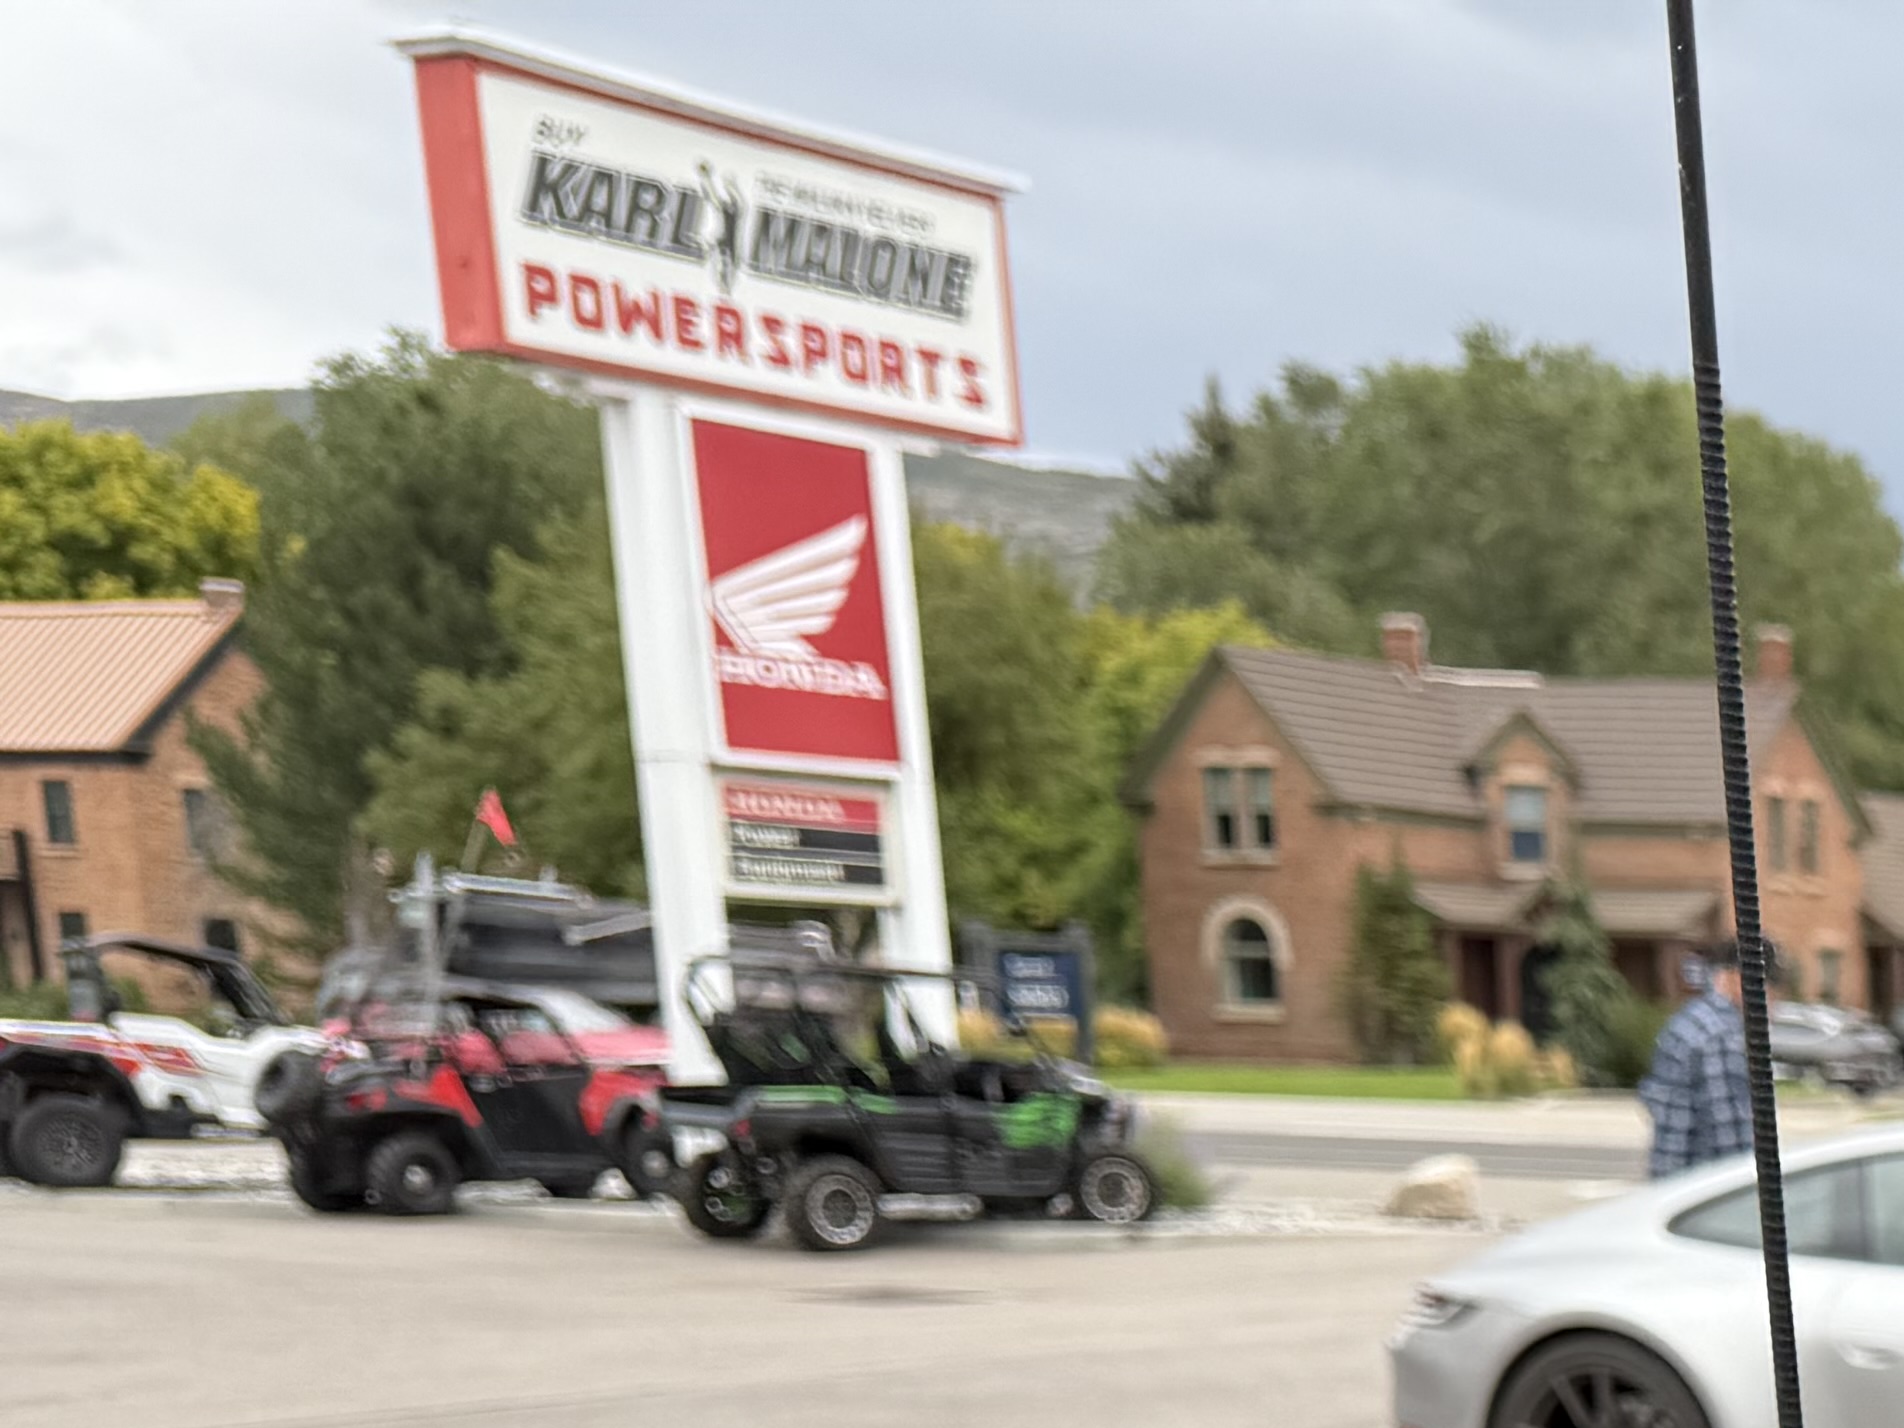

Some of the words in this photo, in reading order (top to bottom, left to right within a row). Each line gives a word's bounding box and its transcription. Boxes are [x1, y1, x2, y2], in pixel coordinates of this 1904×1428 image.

[520, 150, 705, 262] KARL
[747, 205, 972, 318] MALONE
[519, 262, 986, 407] POWERSPORTS
[718, 650, 889, 700] HONDA
